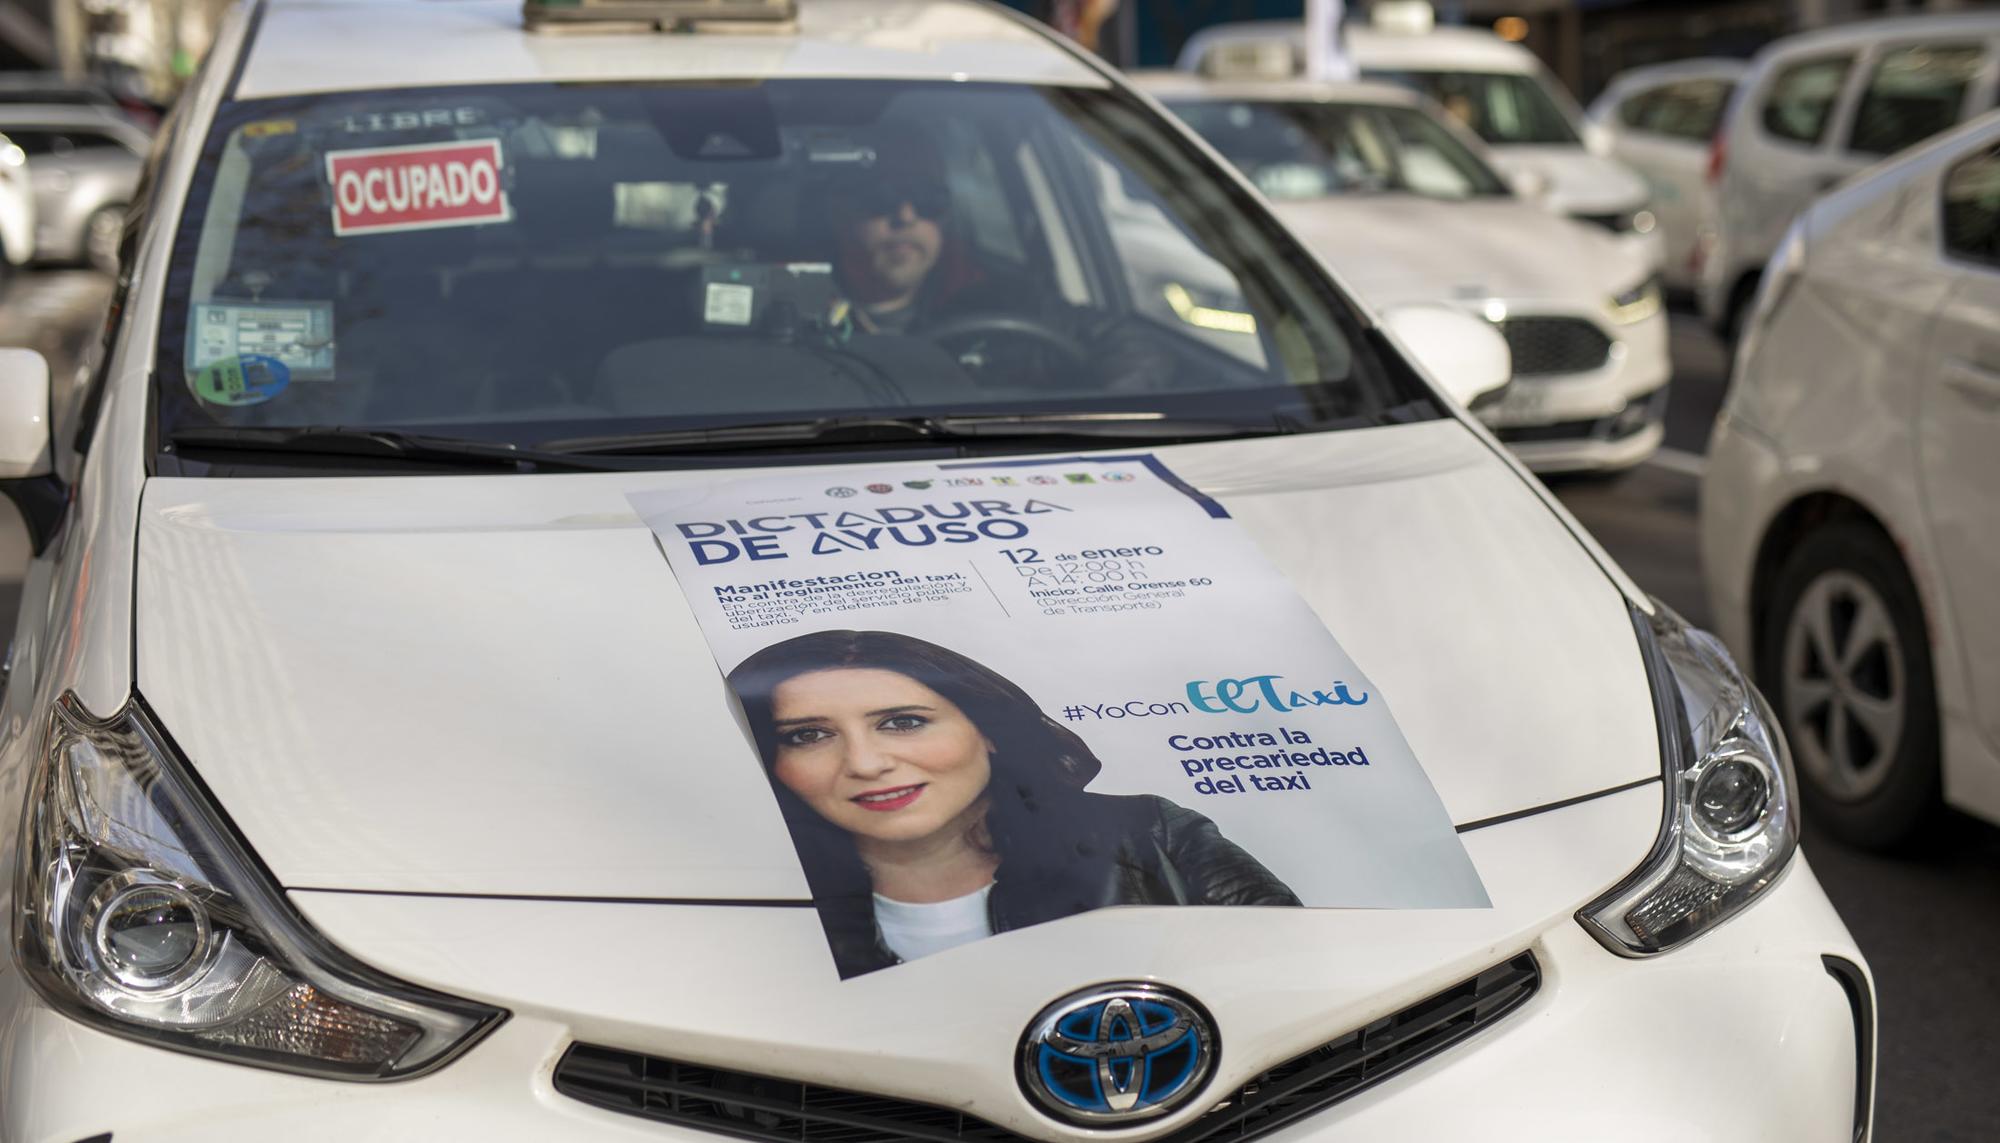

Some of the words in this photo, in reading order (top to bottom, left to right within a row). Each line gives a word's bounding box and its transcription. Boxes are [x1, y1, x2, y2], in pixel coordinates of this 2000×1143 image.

[345, 107, 477, 132] LIBRE
[337, 158, 497, 216] OCUPADO
[675, 499, 1074, 539] DICTADURA
[688, 535, 789, 566] DE
[811, 518, 1029, 554] AYUSO
[998, 548, 1046, 565] 12
[1055, 553, 1078, 561] de
[1081, 546, 1163, 559] enero
[1016, 565, 1054, 577] De
[1056, 560, 1121, 574] 12:00
[1125, 559, 1145, 570] h
[713, 570, 900, 596] Manifestacion
[718, 596, 747, 604] No
[753, 592, 769, 600] al
[775, 581, 886, 597] reglamento
[891, 576, 921, 586] del
[926, 572, 966, 582] taxi.
[1028, 576, 1048, 588] A
[1128, 569, 1148, 580] h
[1029, 587, 1080, 598] Inicio:
[1083, 584, 1124, 594] Calle
[1127, 580, 1187, 591] Orense
[1188, 577, 1212, 587] 60
[722, 603, 743, 612] En
[748, 599, 799, 609] contra
[804, 594, 823, 603] de
[828, 592, 841, 600] la
[846, 582, 954, 598] desregulación
[725, 601, 818, 617] uberización
[823, 595, 847, 607] del
[851, 591, 911, 602] servicio
[729, 615, 754, 624] del
[758, 611, 792, 621] taxi.
[795, 607, 807, 616] Y
[812, 606, 832, 614] en
[836, 600, 898, 612] defensa
[902, 596, 922, 605] de
[925, 593, 949, 602] los
[1036, 594, 1121, 607] (Dirección
[1123, 588, 1185, 601] General
[1043, 606, 1066, 616] de
[1068, 600, 1162, 613] Transporte)
[732, 617, 799, 630] usuarios
[1168, 729, 1278, 751] Contra
[1278, 727, 1312, 745] la
[1180, 747, 1370, 777] precariedad
[1194, 774, 1247, 795] del
[1248, 771, 1311, 792] taxi
